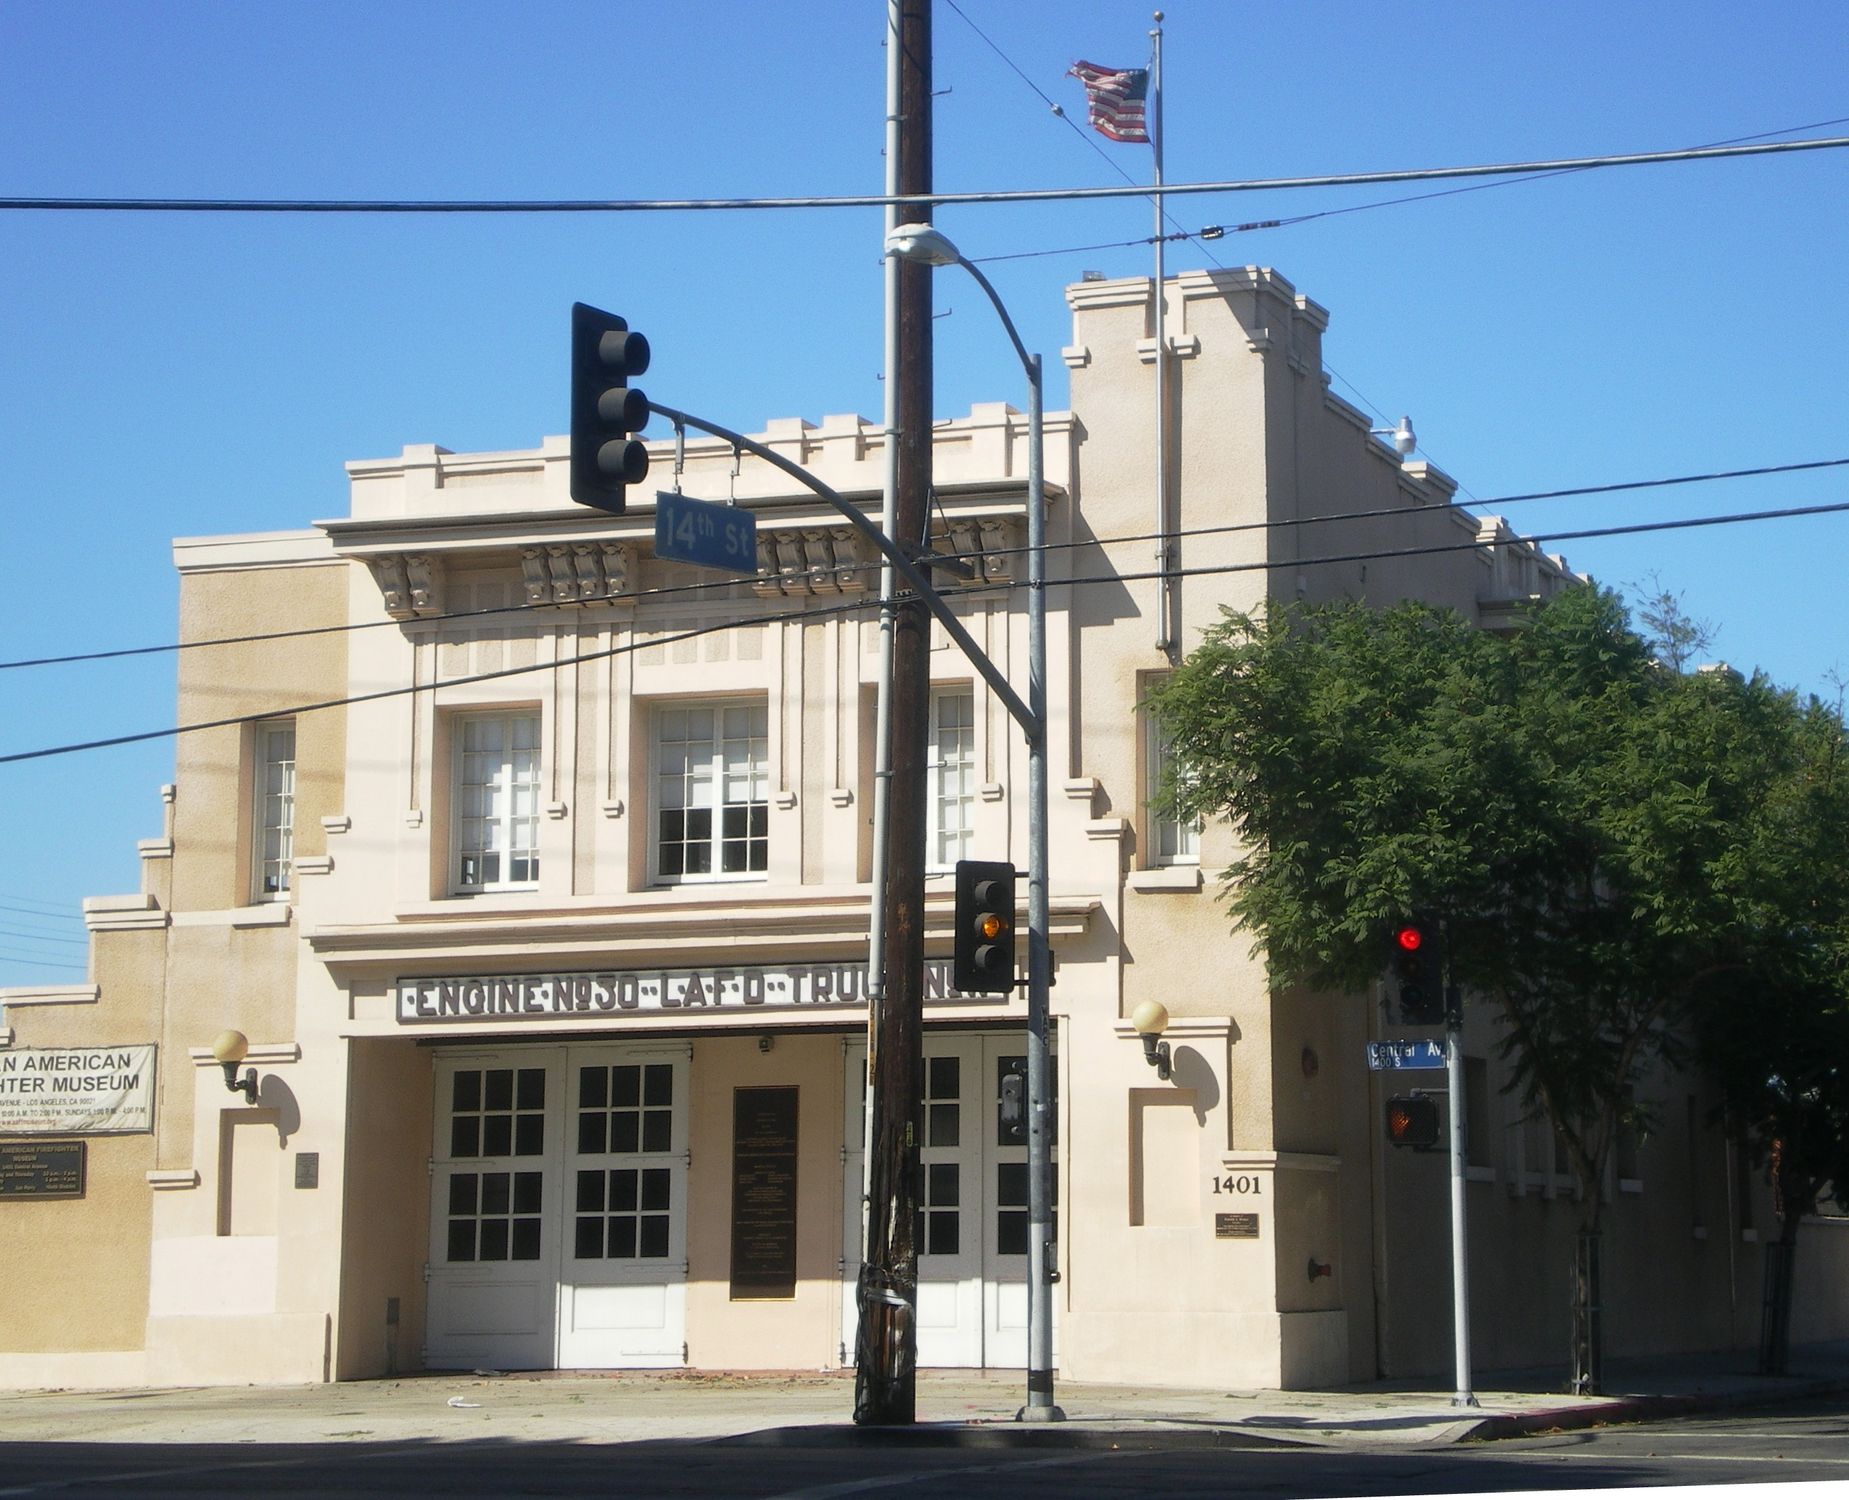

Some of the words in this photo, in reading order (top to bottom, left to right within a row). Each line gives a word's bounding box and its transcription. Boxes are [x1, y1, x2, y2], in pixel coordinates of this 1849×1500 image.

[666, 506, 714, 550] 14th
[725, 522, 749, 557] St
[1371, 1043, 1415, 1058] Central
[1427, 1041, 1442, 1057] Av
[0, 1057, 17, 1073] N
[23, 1053, 132, 1073] AMERICAN
[1372, 1057, 1391, 1068] 1400
[1394, 1056, 1401, 1068] S
[52, 1074, 140, 1093] MUSEUM
[69, 1097, 78, 1105] CA
[30, 1109, 39, 1117] TO
[1213, 1175, 1262, 1194] 1401
